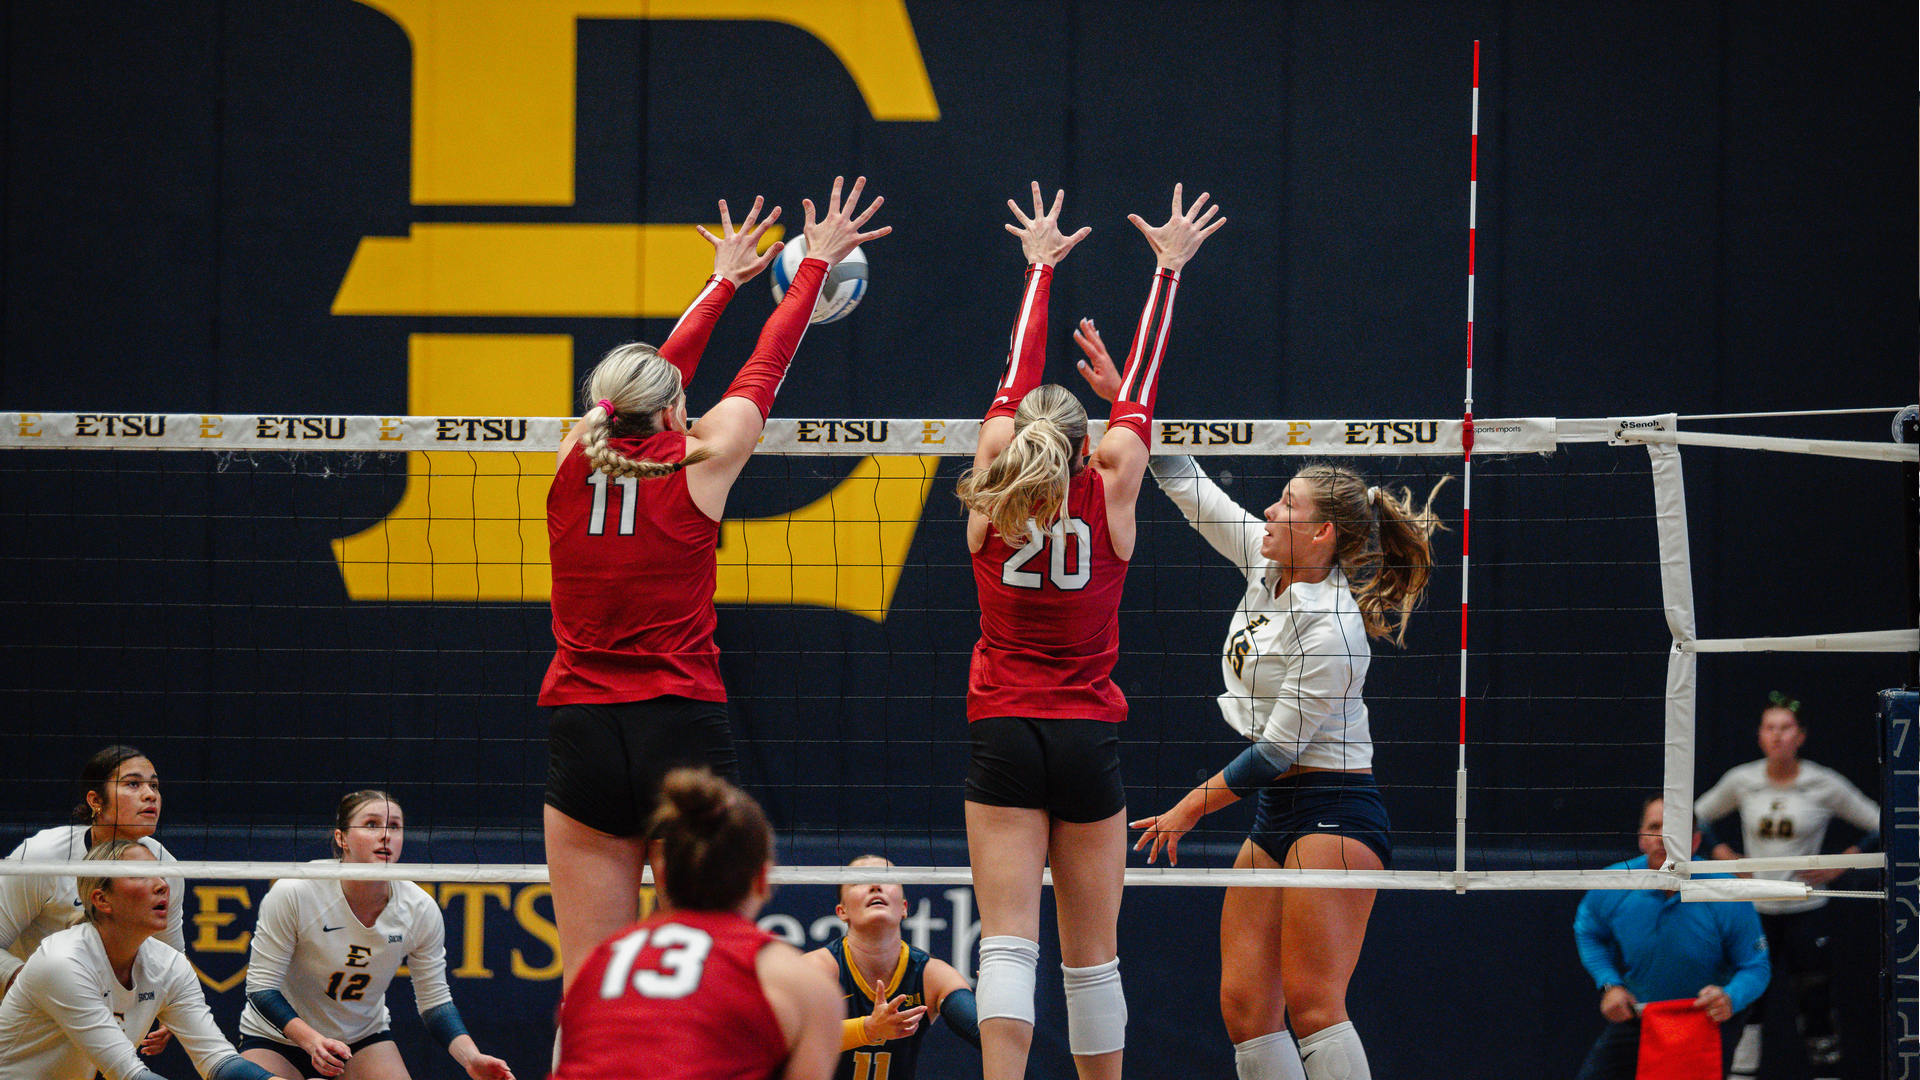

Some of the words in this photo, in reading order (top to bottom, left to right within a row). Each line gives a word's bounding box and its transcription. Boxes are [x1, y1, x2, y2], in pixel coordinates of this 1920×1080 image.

[331, 0, 940, 622] E
[18, 413, 43, 438] E
[75, 415, 166, 438] ETSU
[199, 415, 224, 439] E
[256, 417, 347, 440] ETSU
[379, 418, 404, 441] E
[436, 418, 528, 442] ETSU
[797, 420, 889, 443] ETSU
[922, 421, 946, 444] E
[1160, 422, 1254, 446] ETSU
[1287, 422, 1312, 445] E
[1344, 422, 1439, 446] ETSU
[1474, 427, 1495, 435] sports
[1629, 419, 1660, 429] Senoh
[586, 466, 639, 536] 11
[1001, 516, 1092, 591] 20
[1758, 816, 1794, 840] 20
[192, 886, 252, 953] E
[345, 944, 372, 969] E
[600, 923, 714, 1000] 13
[324, 971, 372, 1001] 12
